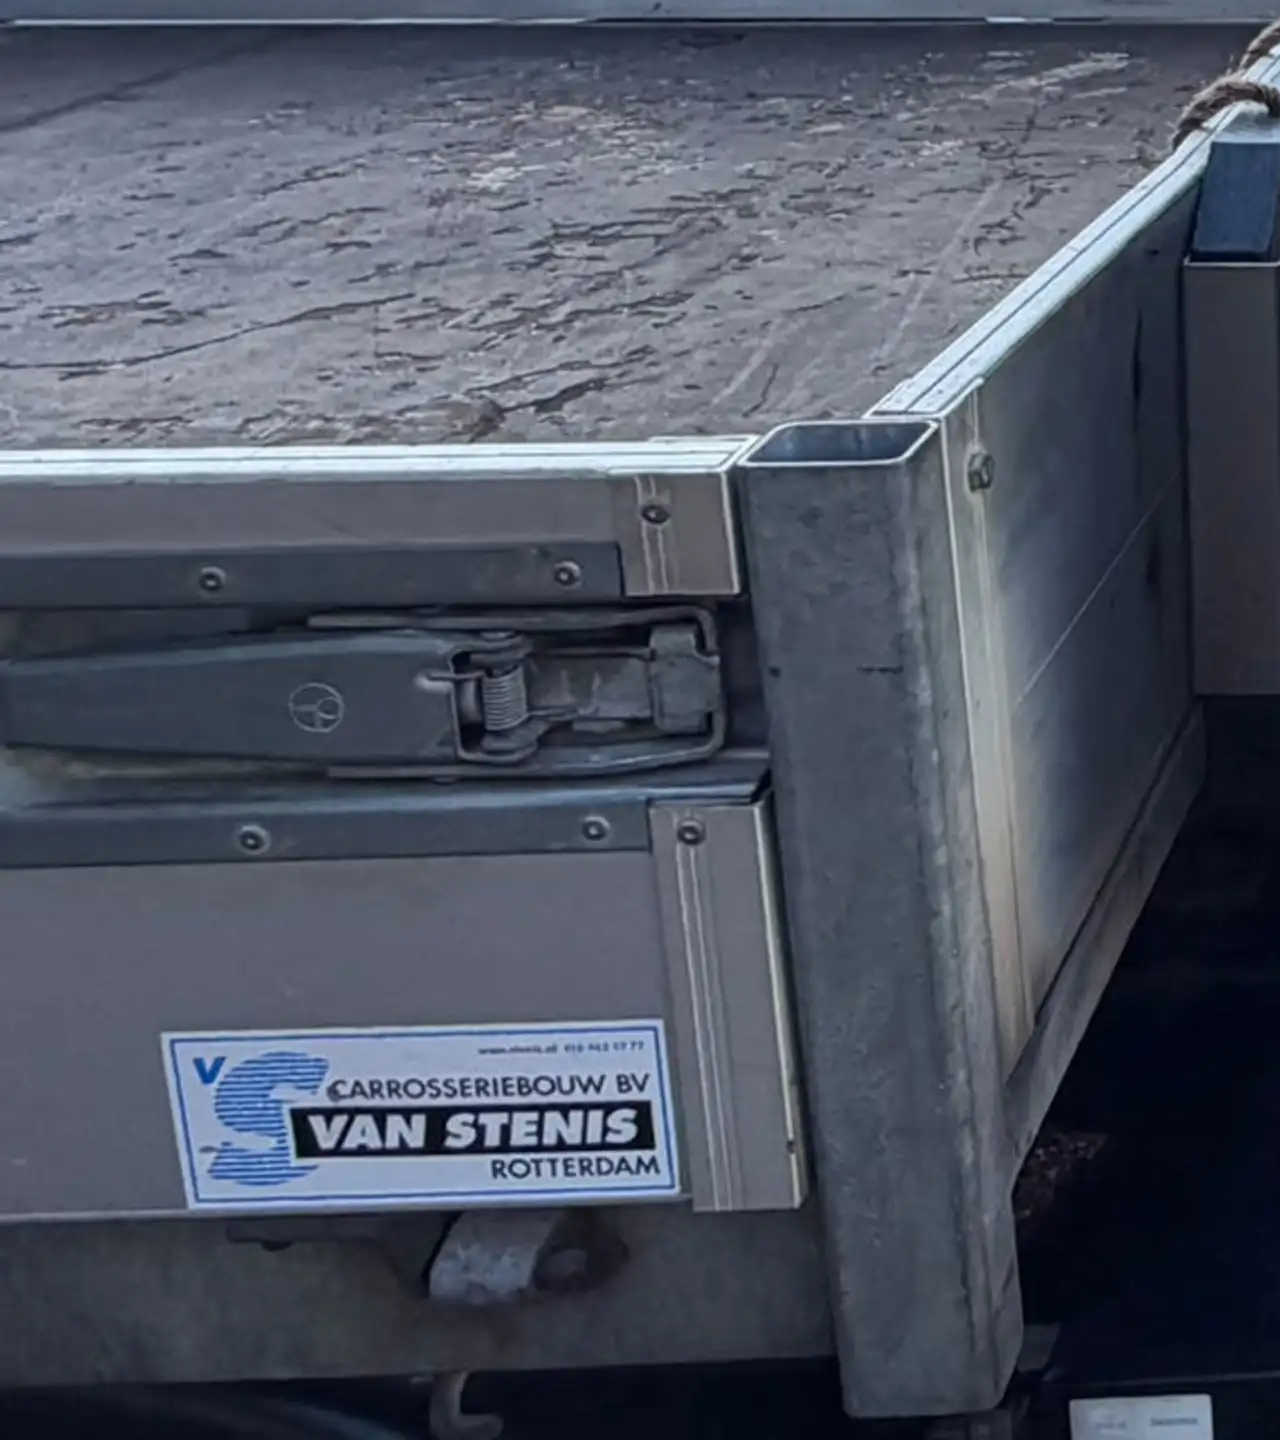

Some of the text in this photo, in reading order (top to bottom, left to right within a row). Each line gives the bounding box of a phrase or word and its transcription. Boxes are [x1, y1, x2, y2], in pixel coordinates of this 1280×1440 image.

[327, 1073, 650, 1101] CARROSSERIEBOUW BV
[306, 1107, 640, 1150] VAN STENIS
[491, 1155, 661, 1179] ROTTERDAM
